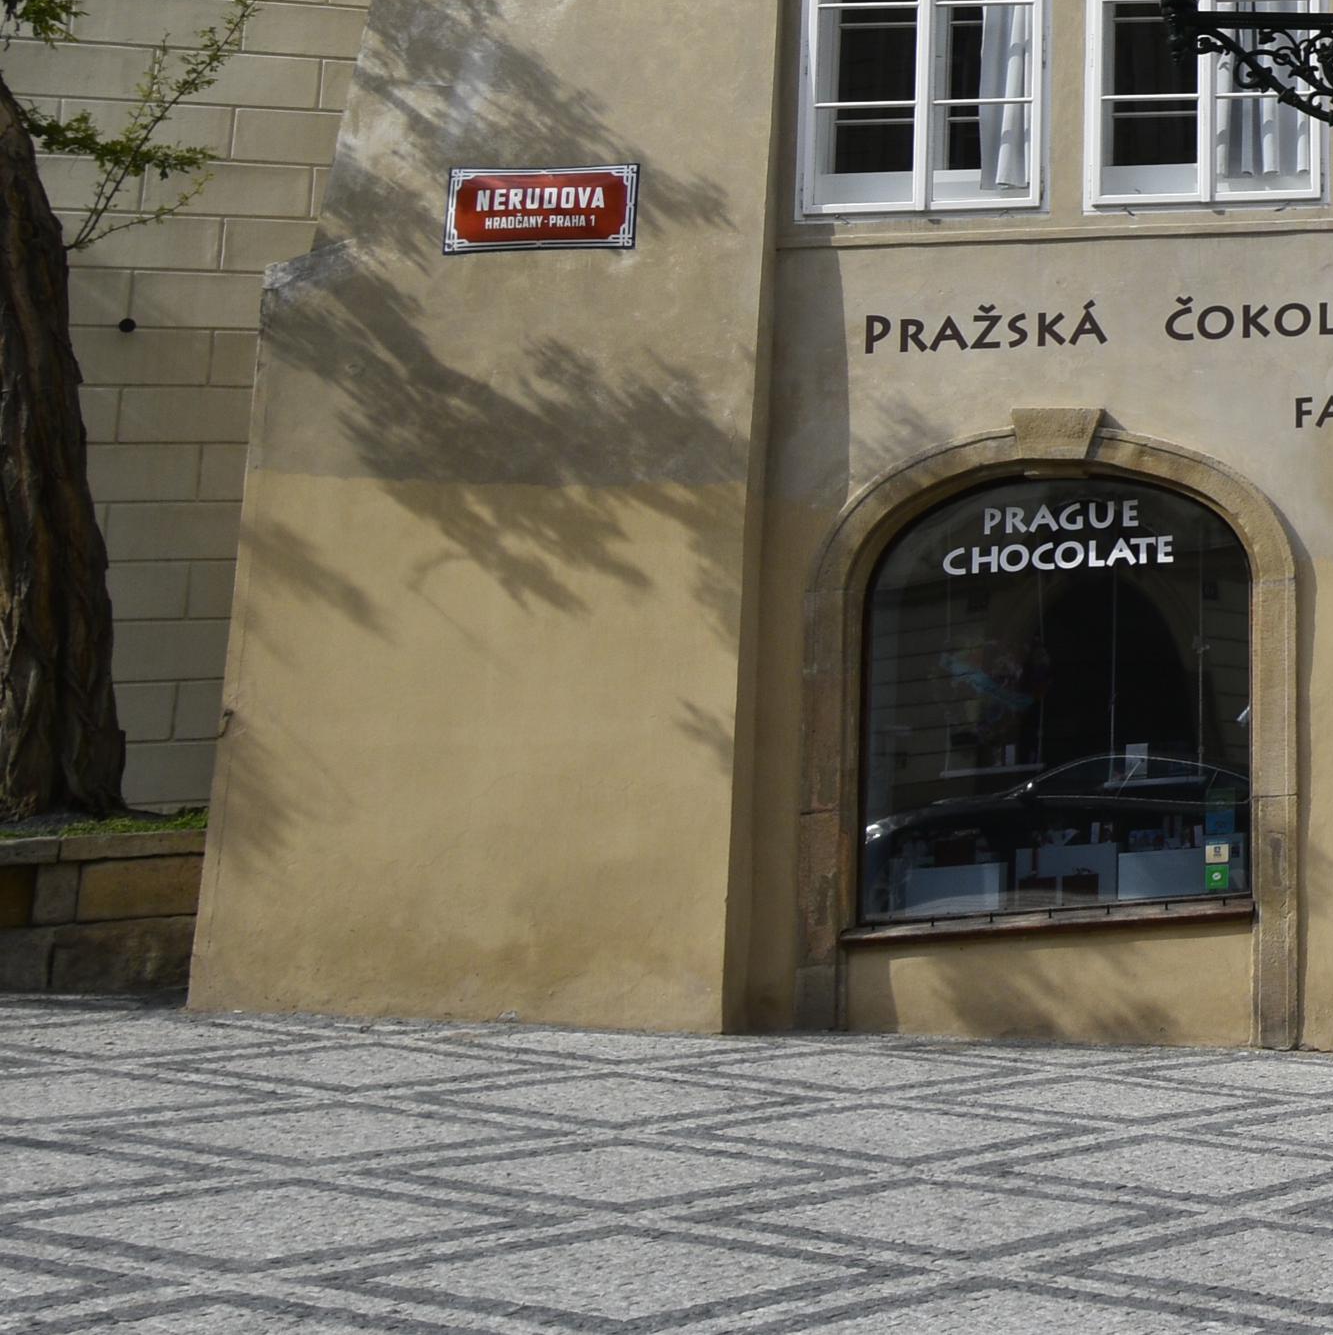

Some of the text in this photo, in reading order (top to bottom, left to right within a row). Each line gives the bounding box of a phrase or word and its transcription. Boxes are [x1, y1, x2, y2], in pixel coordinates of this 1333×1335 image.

[476, 187, 605, 211] NERUDOVA
[589, 214, 596, 226] 1
[865, 299, 1108, 354] PRAŽSKÁ
[983, 499, 1139, 535] PRAGUE
[943, 535, 1174, 576] CHOCOLATE
